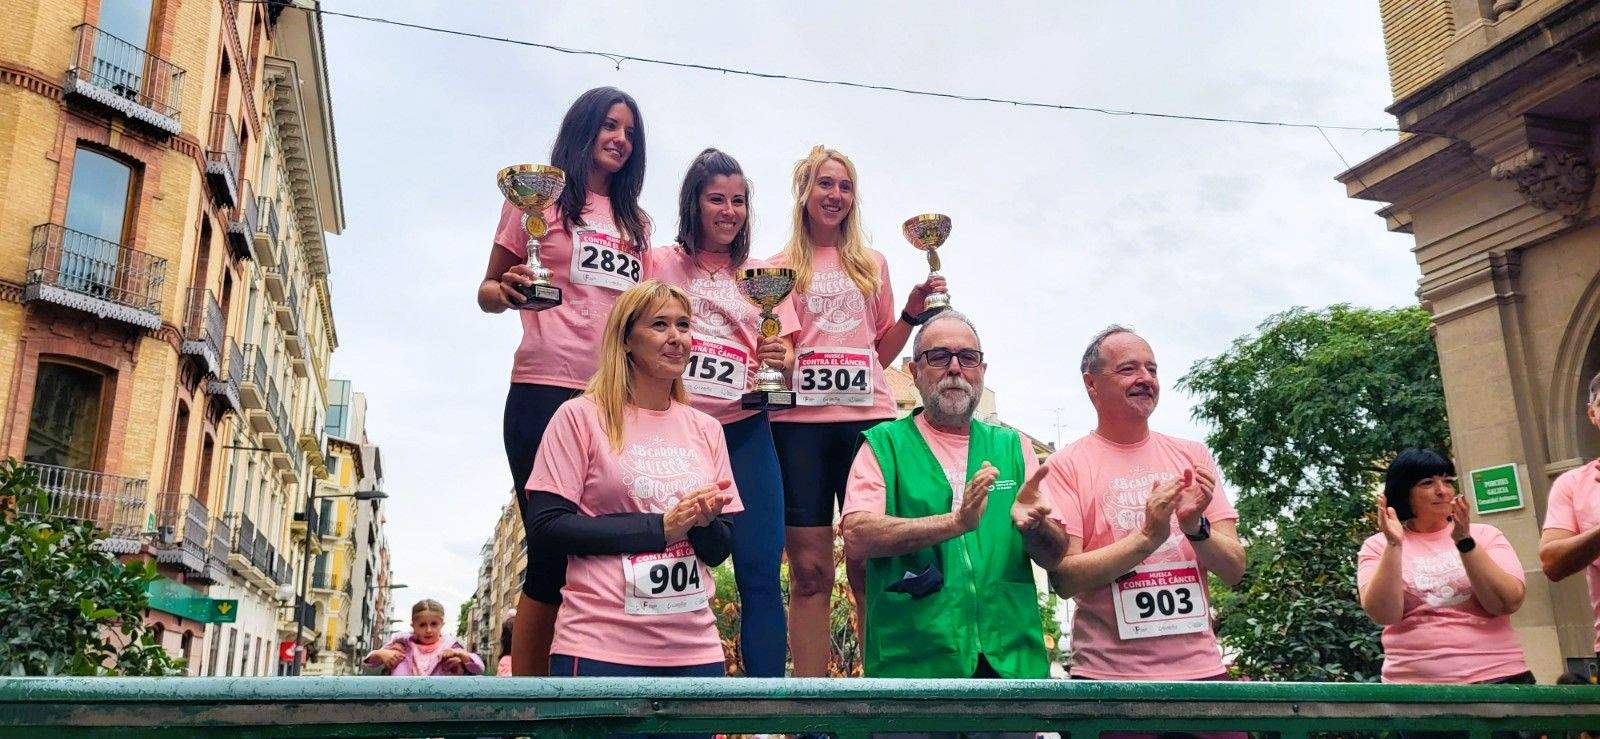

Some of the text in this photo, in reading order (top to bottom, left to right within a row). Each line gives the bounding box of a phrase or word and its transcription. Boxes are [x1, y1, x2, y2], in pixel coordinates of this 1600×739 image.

[581, 245, 641, 283] 2828
[689, 355, 735, 385] 152
[801, 368, 868, 391] 3304
[649, 559, 700, 595] 904
[1123, 575, 1196, 589] CONTRA EL CÁNCER
[1135, 587, 1194, 619] 903
